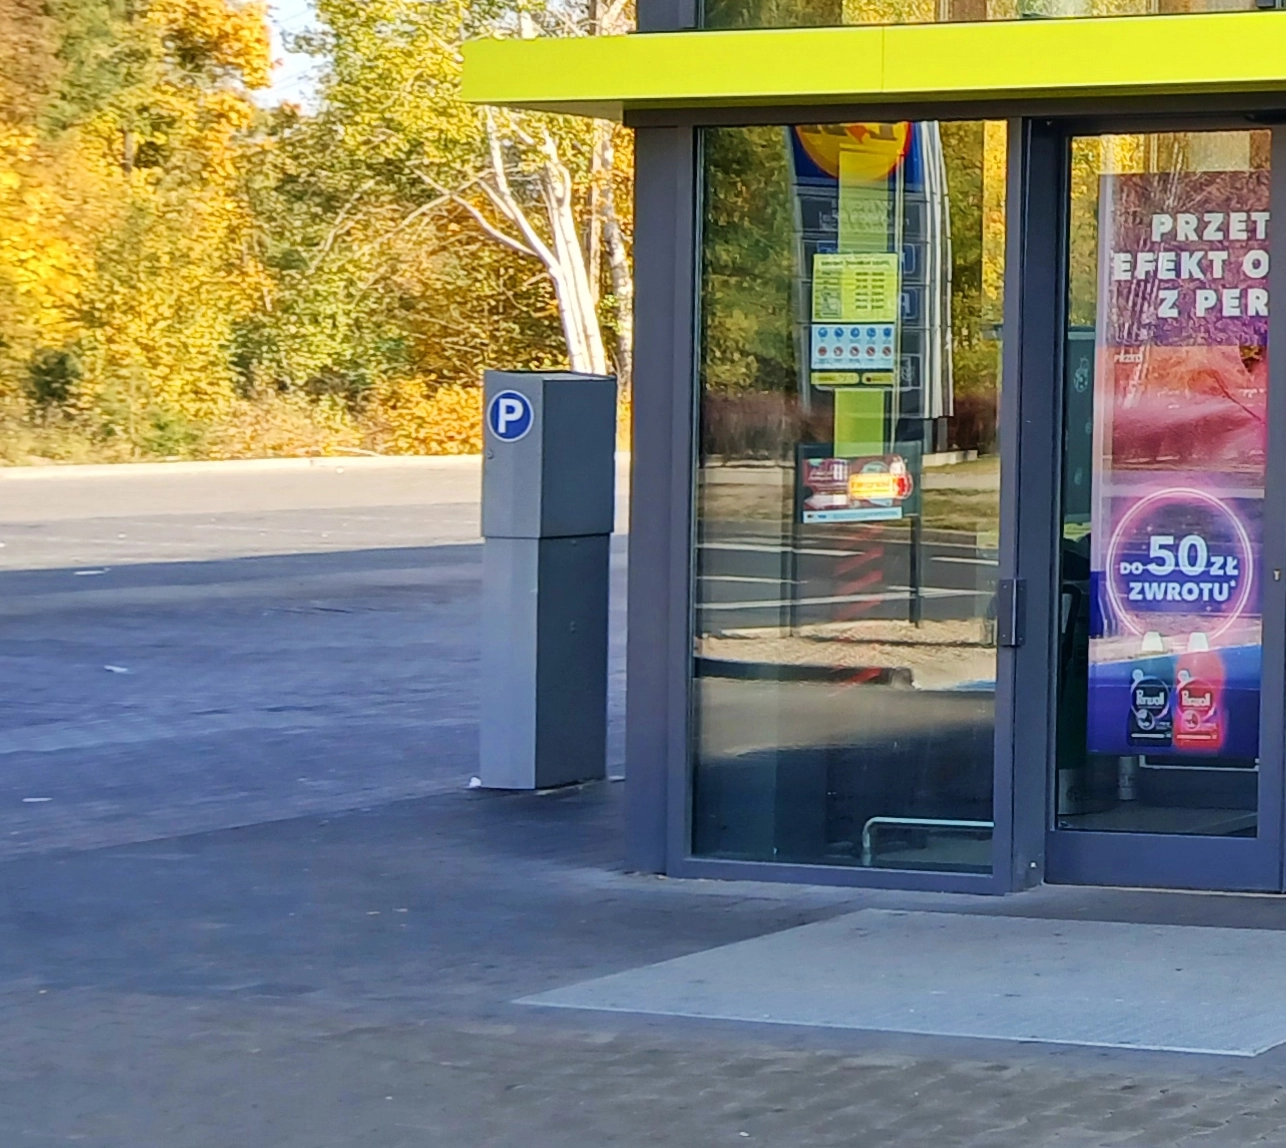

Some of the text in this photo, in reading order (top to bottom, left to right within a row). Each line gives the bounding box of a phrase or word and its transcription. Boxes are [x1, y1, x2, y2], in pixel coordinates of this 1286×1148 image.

[1112, 249, 1227, 281] EFEKT
[1157, 288, 1180, 318] Z
[497, 397, 525, 434] P
[1119, 534, 1239, 576] DO 50 ZŁ
